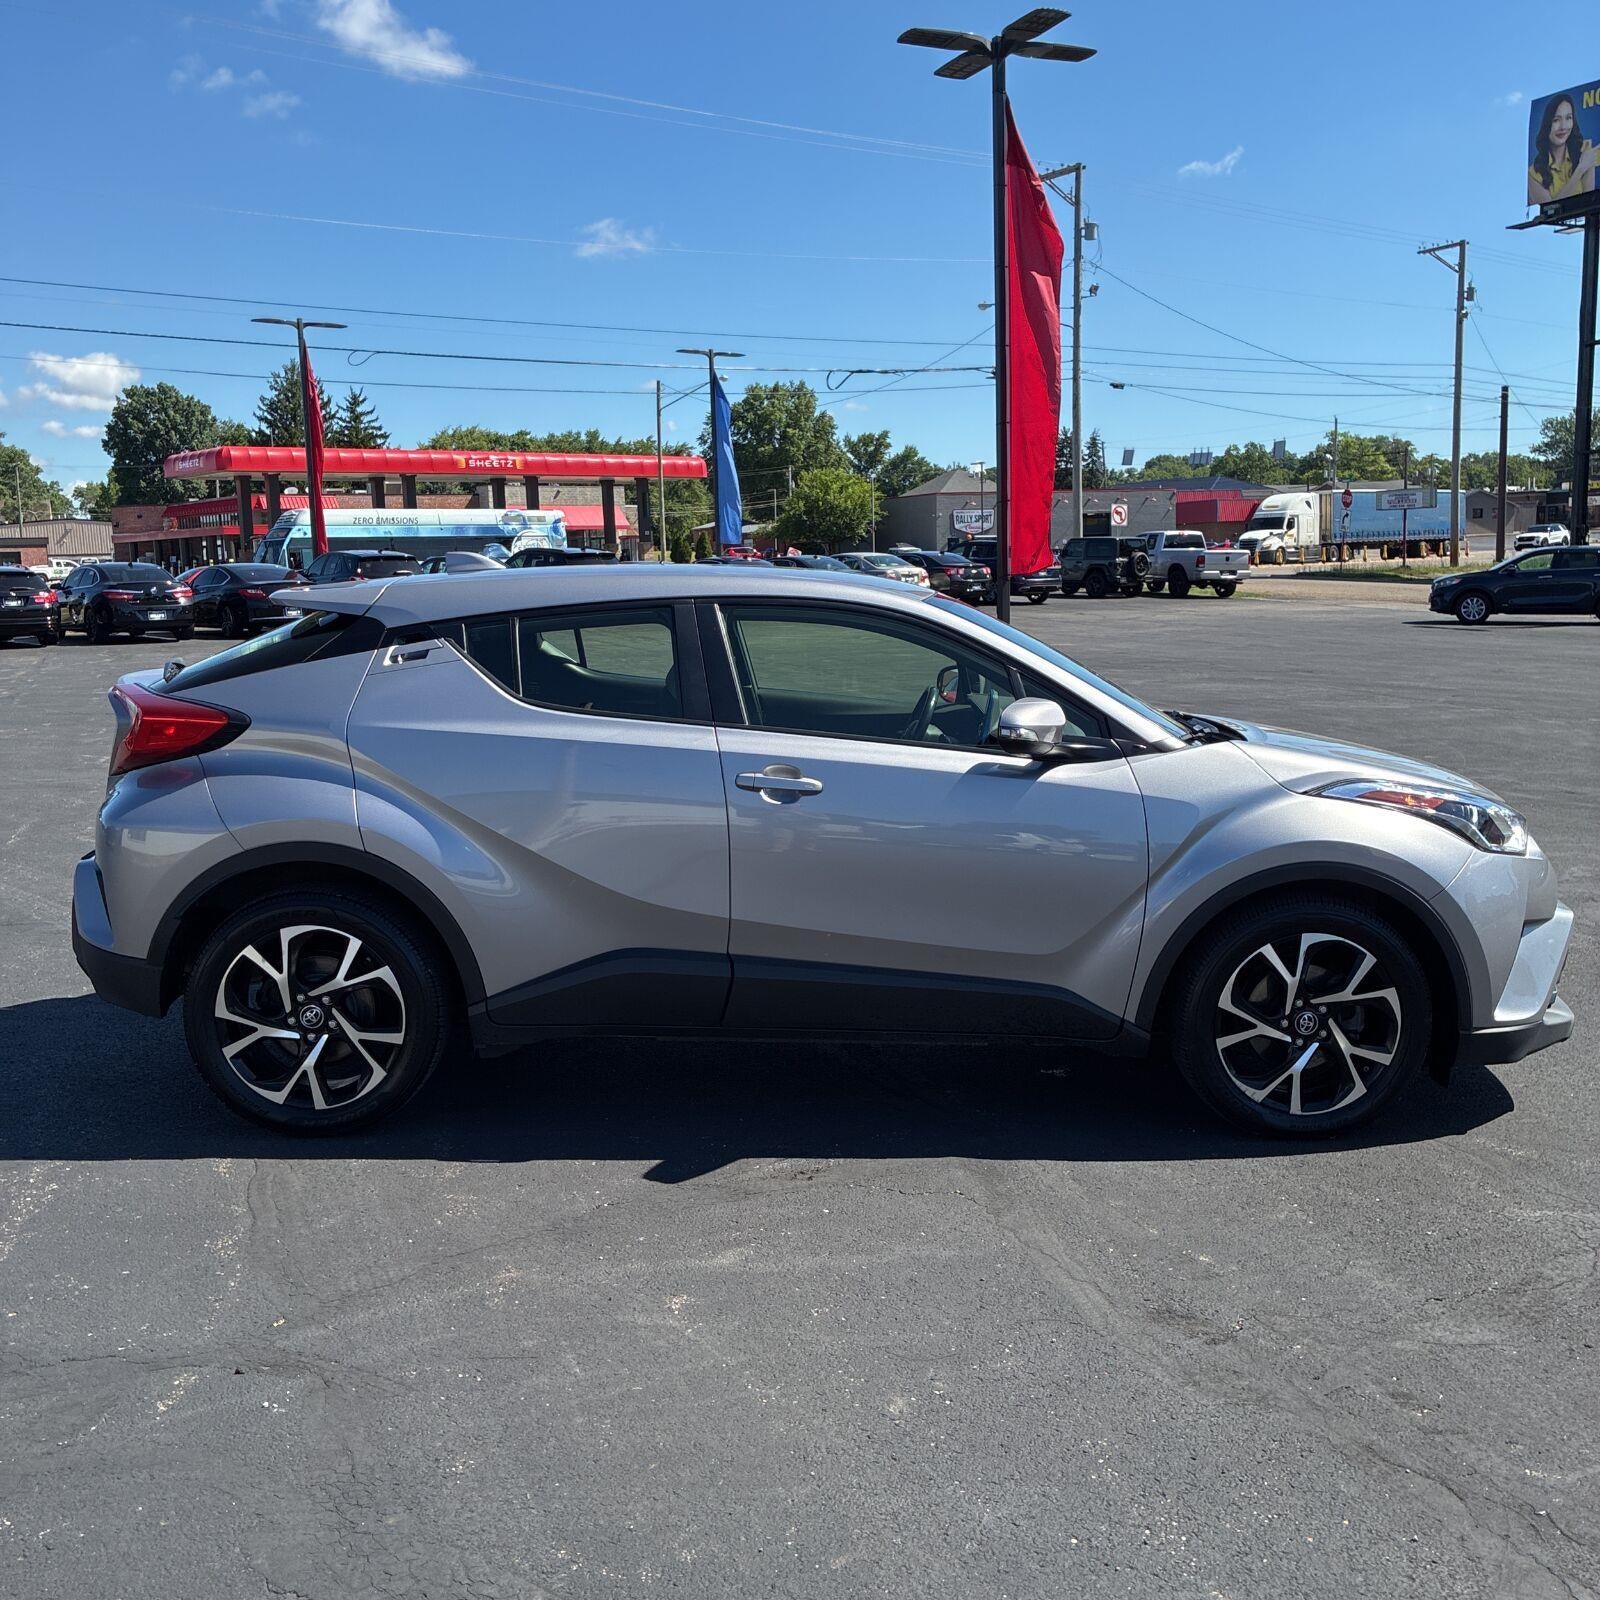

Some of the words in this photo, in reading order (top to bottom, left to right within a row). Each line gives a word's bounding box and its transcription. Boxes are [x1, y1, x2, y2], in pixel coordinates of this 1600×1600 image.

[178, 459, 199, 469] SHEETZ
[469, 459, 513, 468] SHEETZ
[353, 516, 374, 525] ZERO
[376, 516, 419, 525] EMISSIONS
[955, 514, 973, 525] RALLY
[974, 513, 992, 524] SPORT
